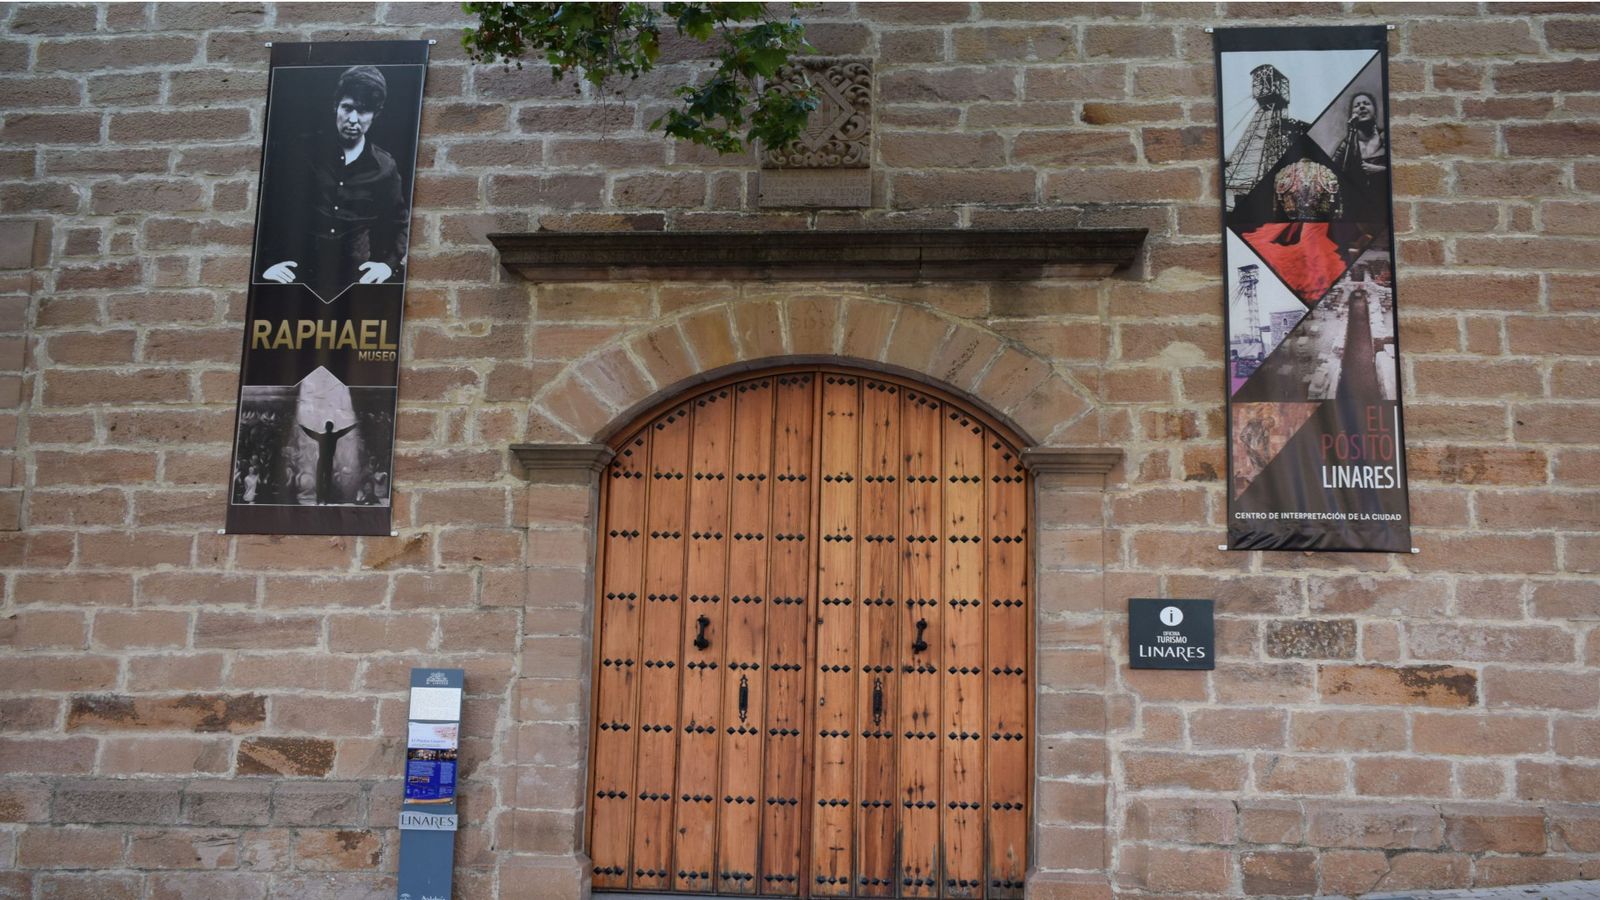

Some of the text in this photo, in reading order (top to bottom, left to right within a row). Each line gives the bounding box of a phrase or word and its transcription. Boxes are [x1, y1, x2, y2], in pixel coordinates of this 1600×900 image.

[251, 319, 398, 350] RAPHAEL
[358, 351, 397, 362] MUSEO
[1366, 405, 1390, 432] EL
[1321, 430, 1393, 461] PÓSITO
[1322, 465, 1395, 489] LINARES
[1235, 512, 1267, 520] CENTRO
[1268, 512, 1280, 520] DE
[1281, 511, 1346, 520] INTERPRETACIÓN
[1360, 513, 1371, 521] LA
[1371, 513, 1402, 521] CIUDAD
[1157, 635, 1188, 644] TURISMO
[1139, 644, 1206, 662] LINARES
[401, 814, 455, 829] LINARES
